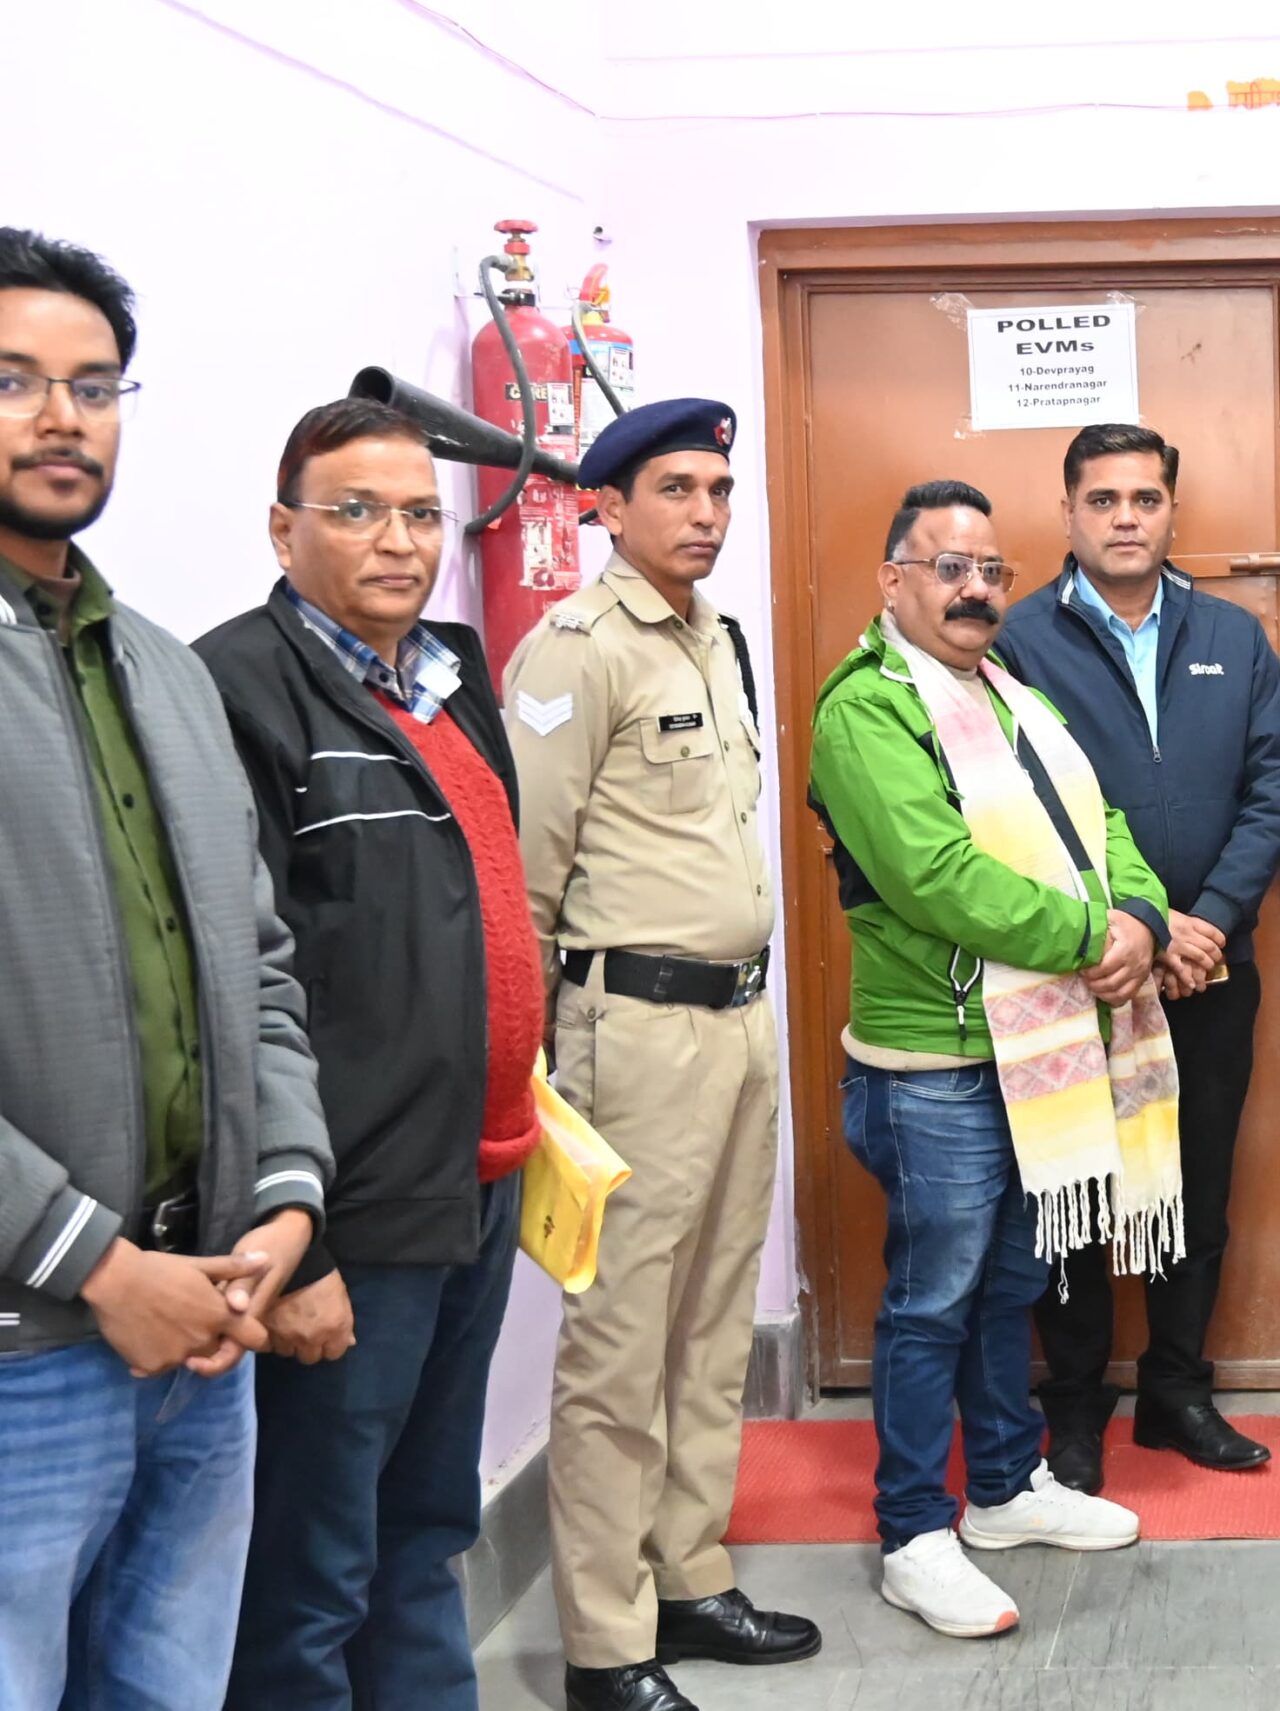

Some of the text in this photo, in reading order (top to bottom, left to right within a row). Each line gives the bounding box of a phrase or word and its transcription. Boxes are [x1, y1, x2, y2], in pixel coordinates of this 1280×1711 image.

[997, 314, 1112, 333] POLLED
[1016, 339, 1096, 356] EVMs
[1019, 364, 1096, 377] 10-Devprayag
[1008, 379, 1108, 393] 11-Narendranagar
[1016, 395, 1102, 408] 12-Pratapnagar
